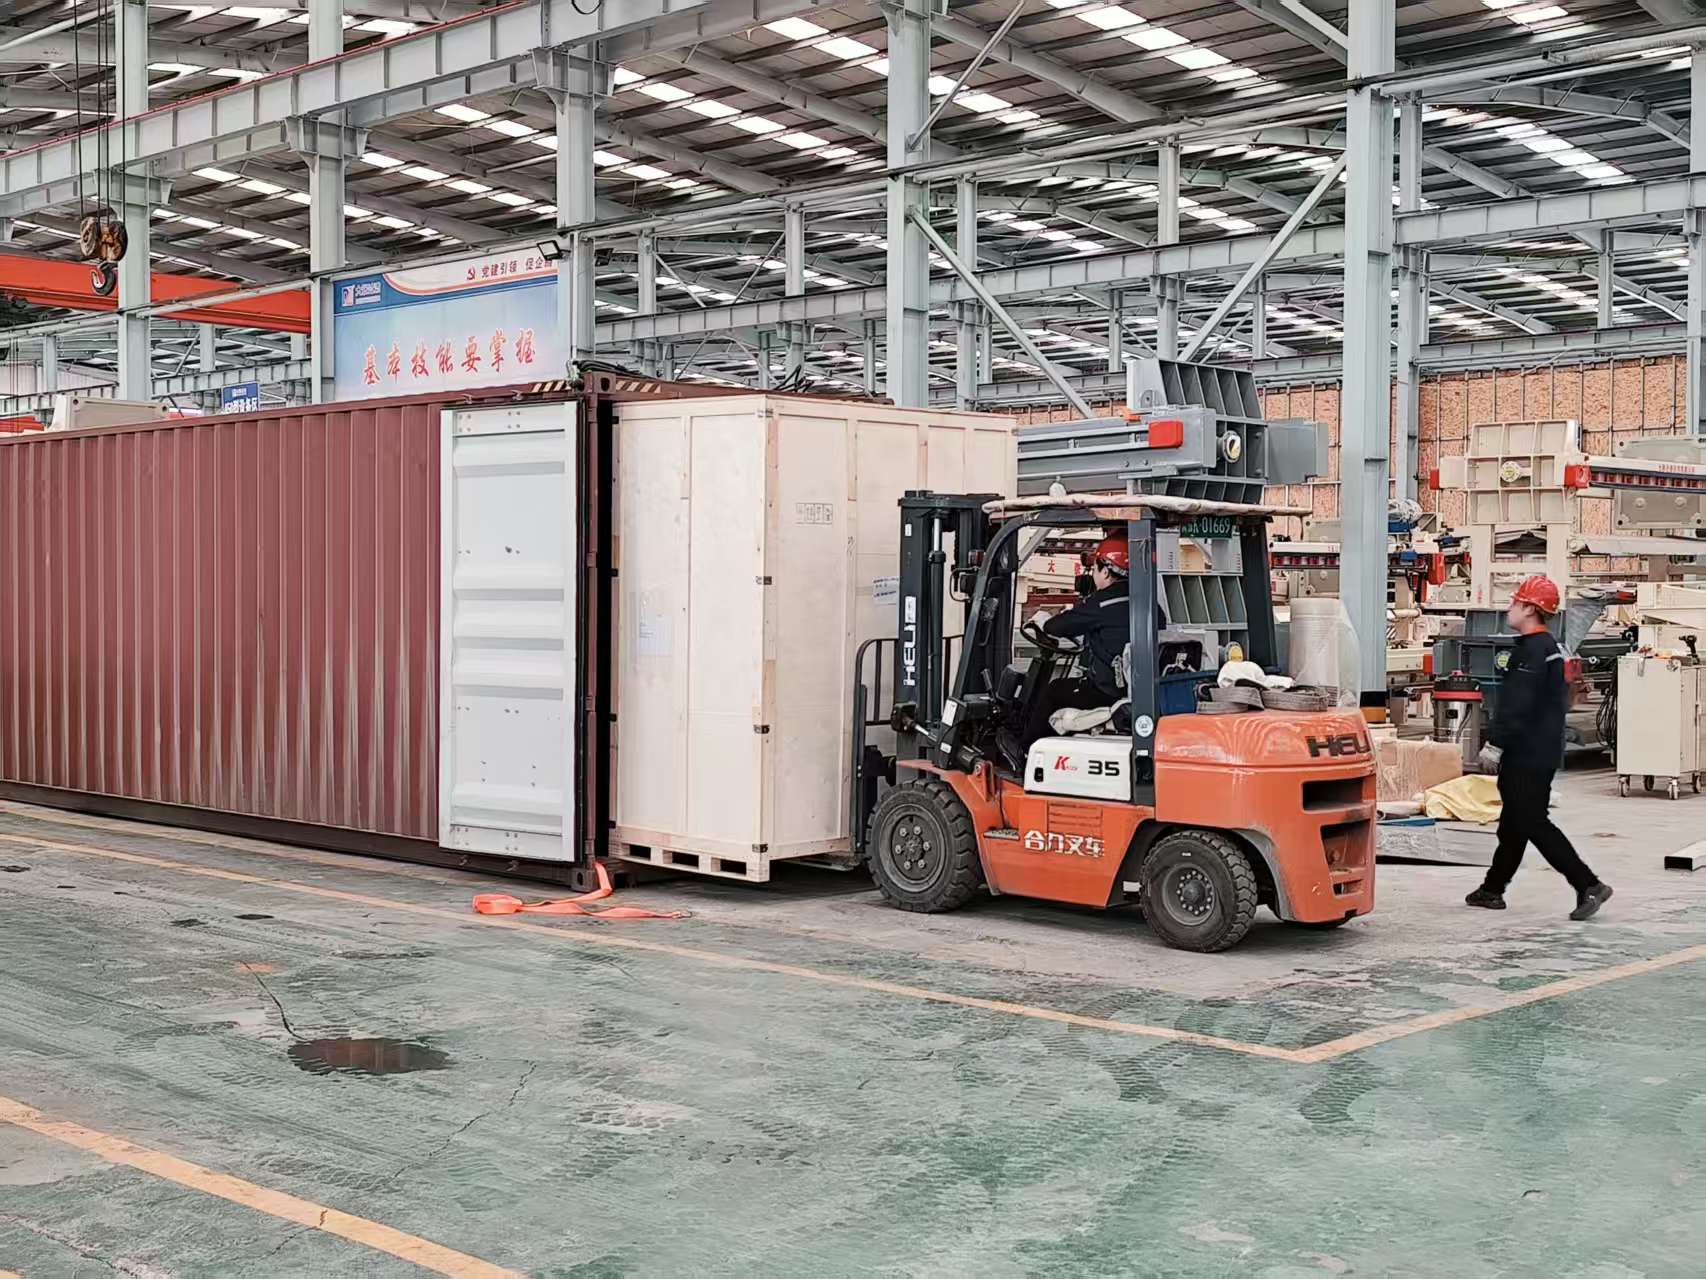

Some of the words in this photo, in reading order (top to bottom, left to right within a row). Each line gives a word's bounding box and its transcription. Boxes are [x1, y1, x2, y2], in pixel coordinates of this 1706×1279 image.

[363, 327, 536, 385] 基本技能要掌握
[1087, 760, 1120, 776] 35
[1024, 829, 1105, 858] 合力叉车
